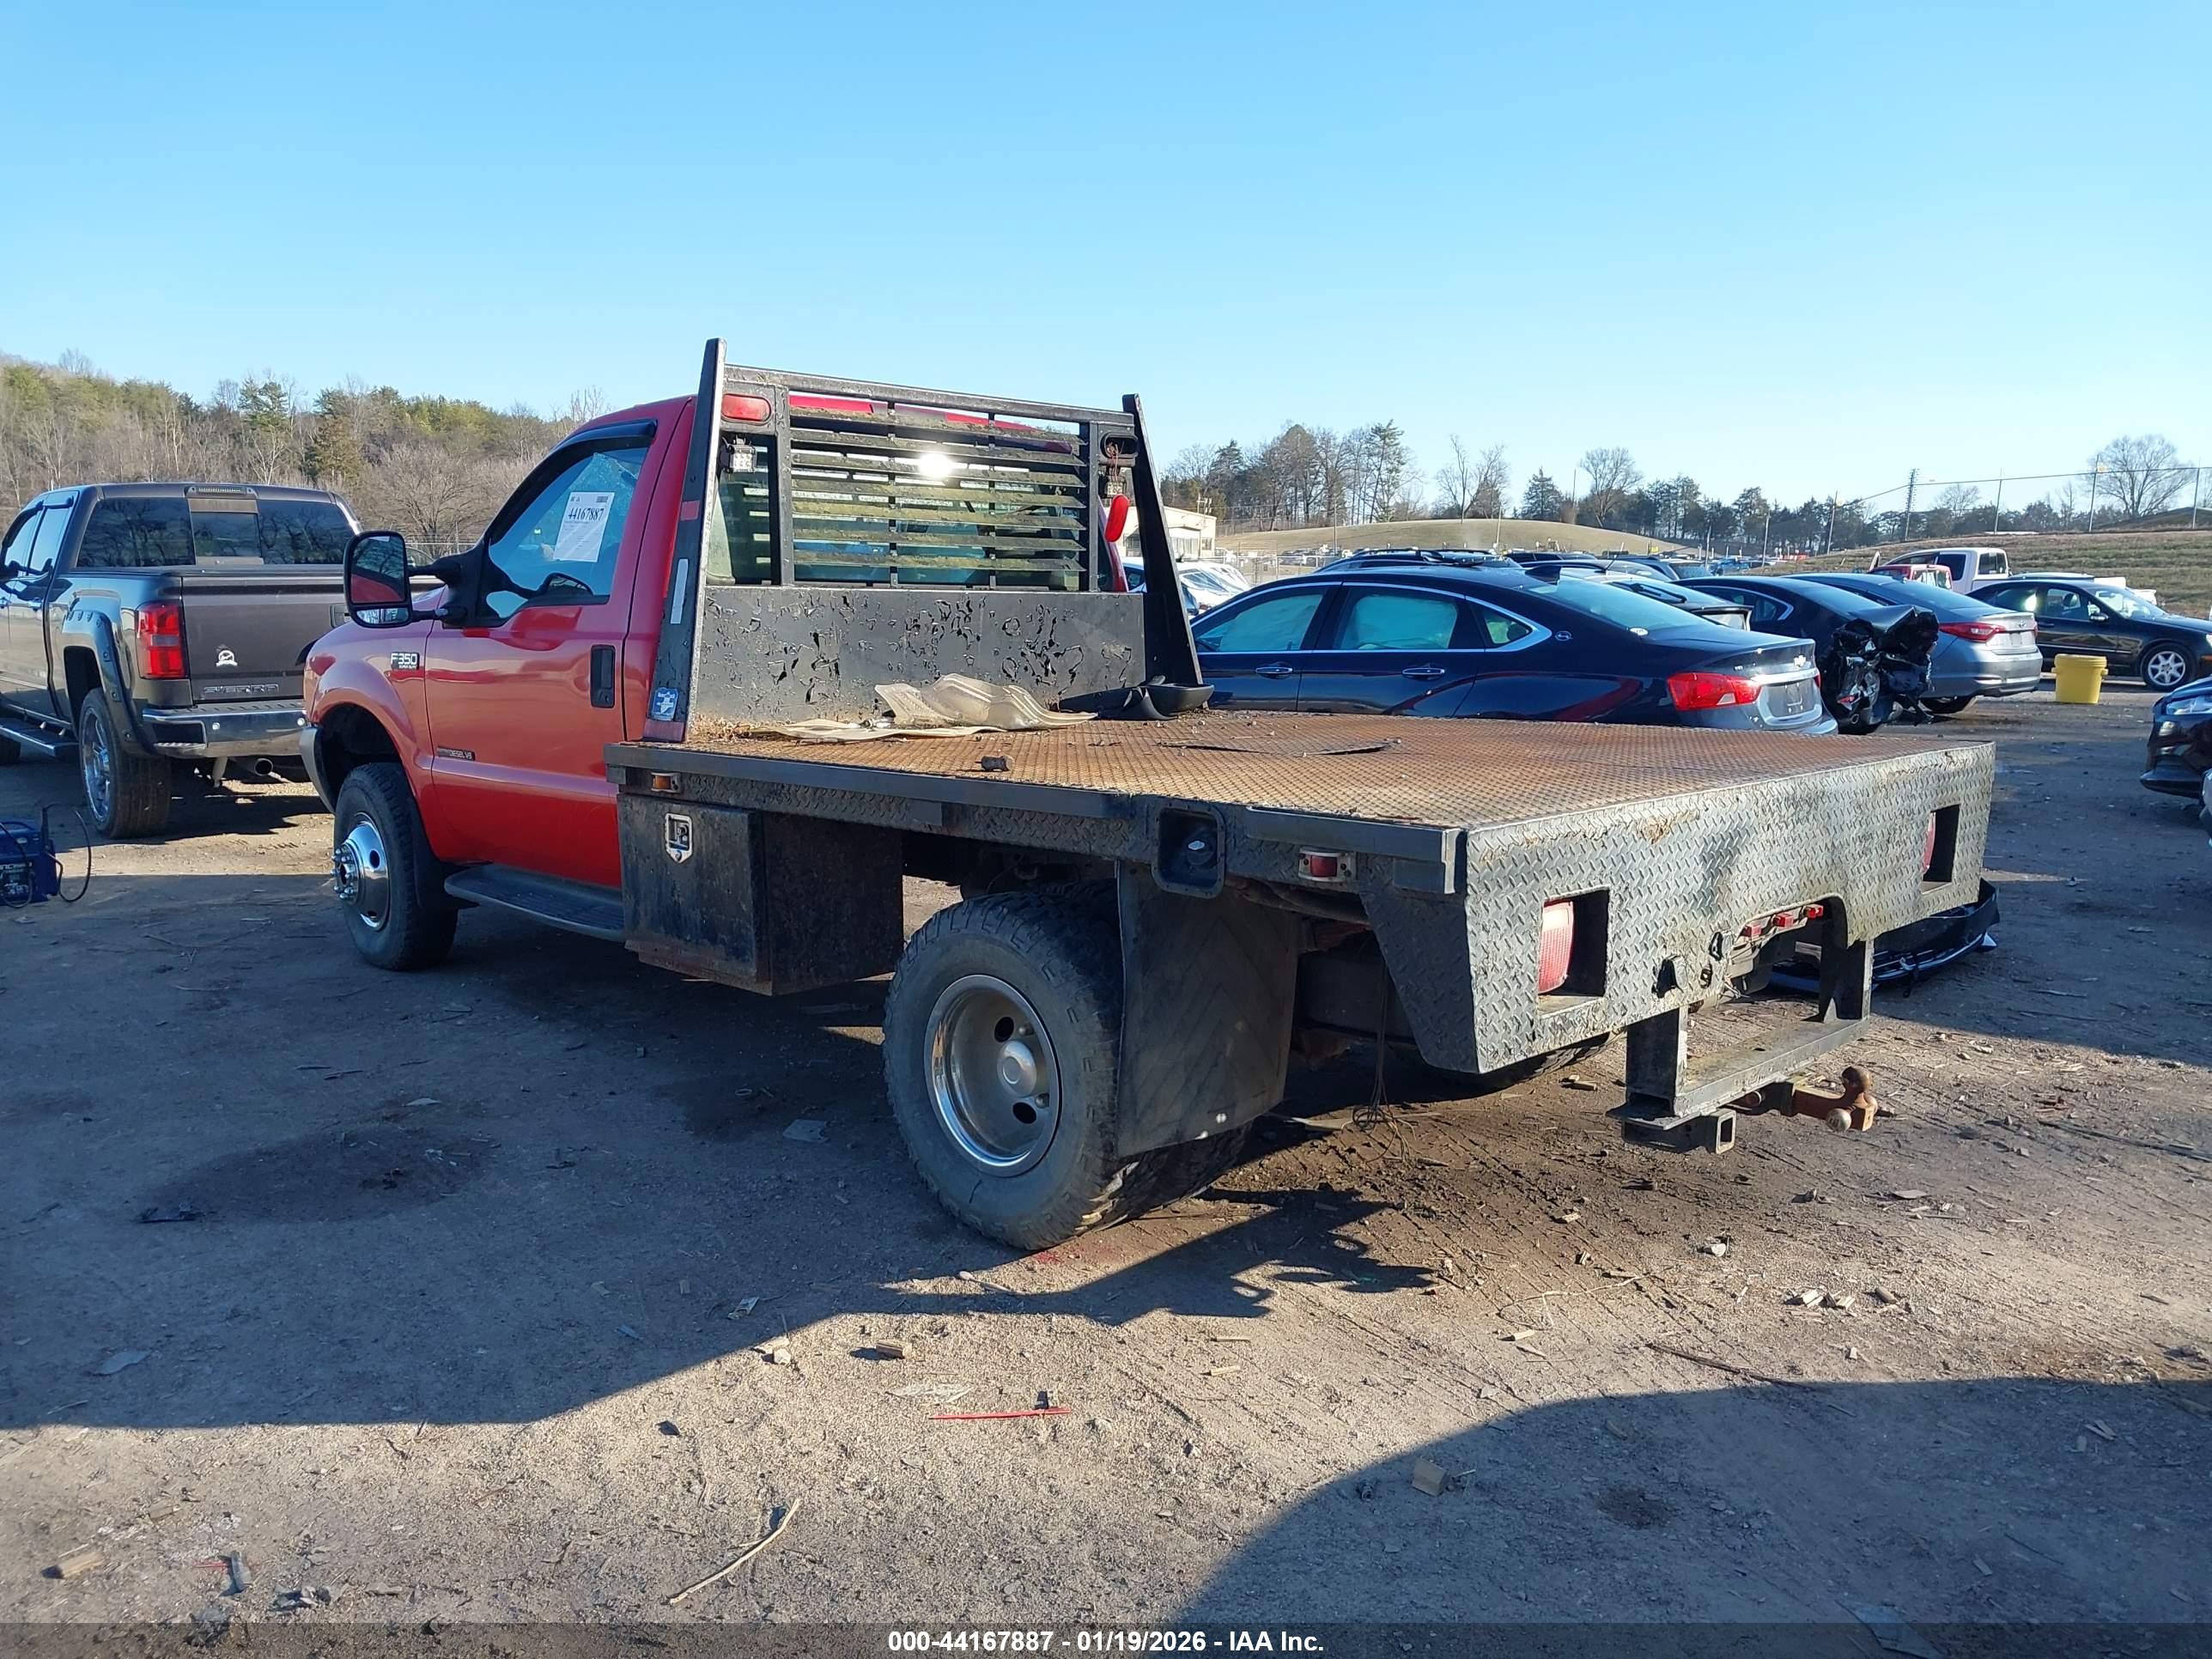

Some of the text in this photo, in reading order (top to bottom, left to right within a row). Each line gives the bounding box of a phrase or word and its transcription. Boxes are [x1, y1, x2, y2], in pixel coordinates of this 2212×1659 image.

[568, 507, 605, 521] 44167887
[391, 653, 417, 665] F350
[204, 684, 279, 693] SIERRA
